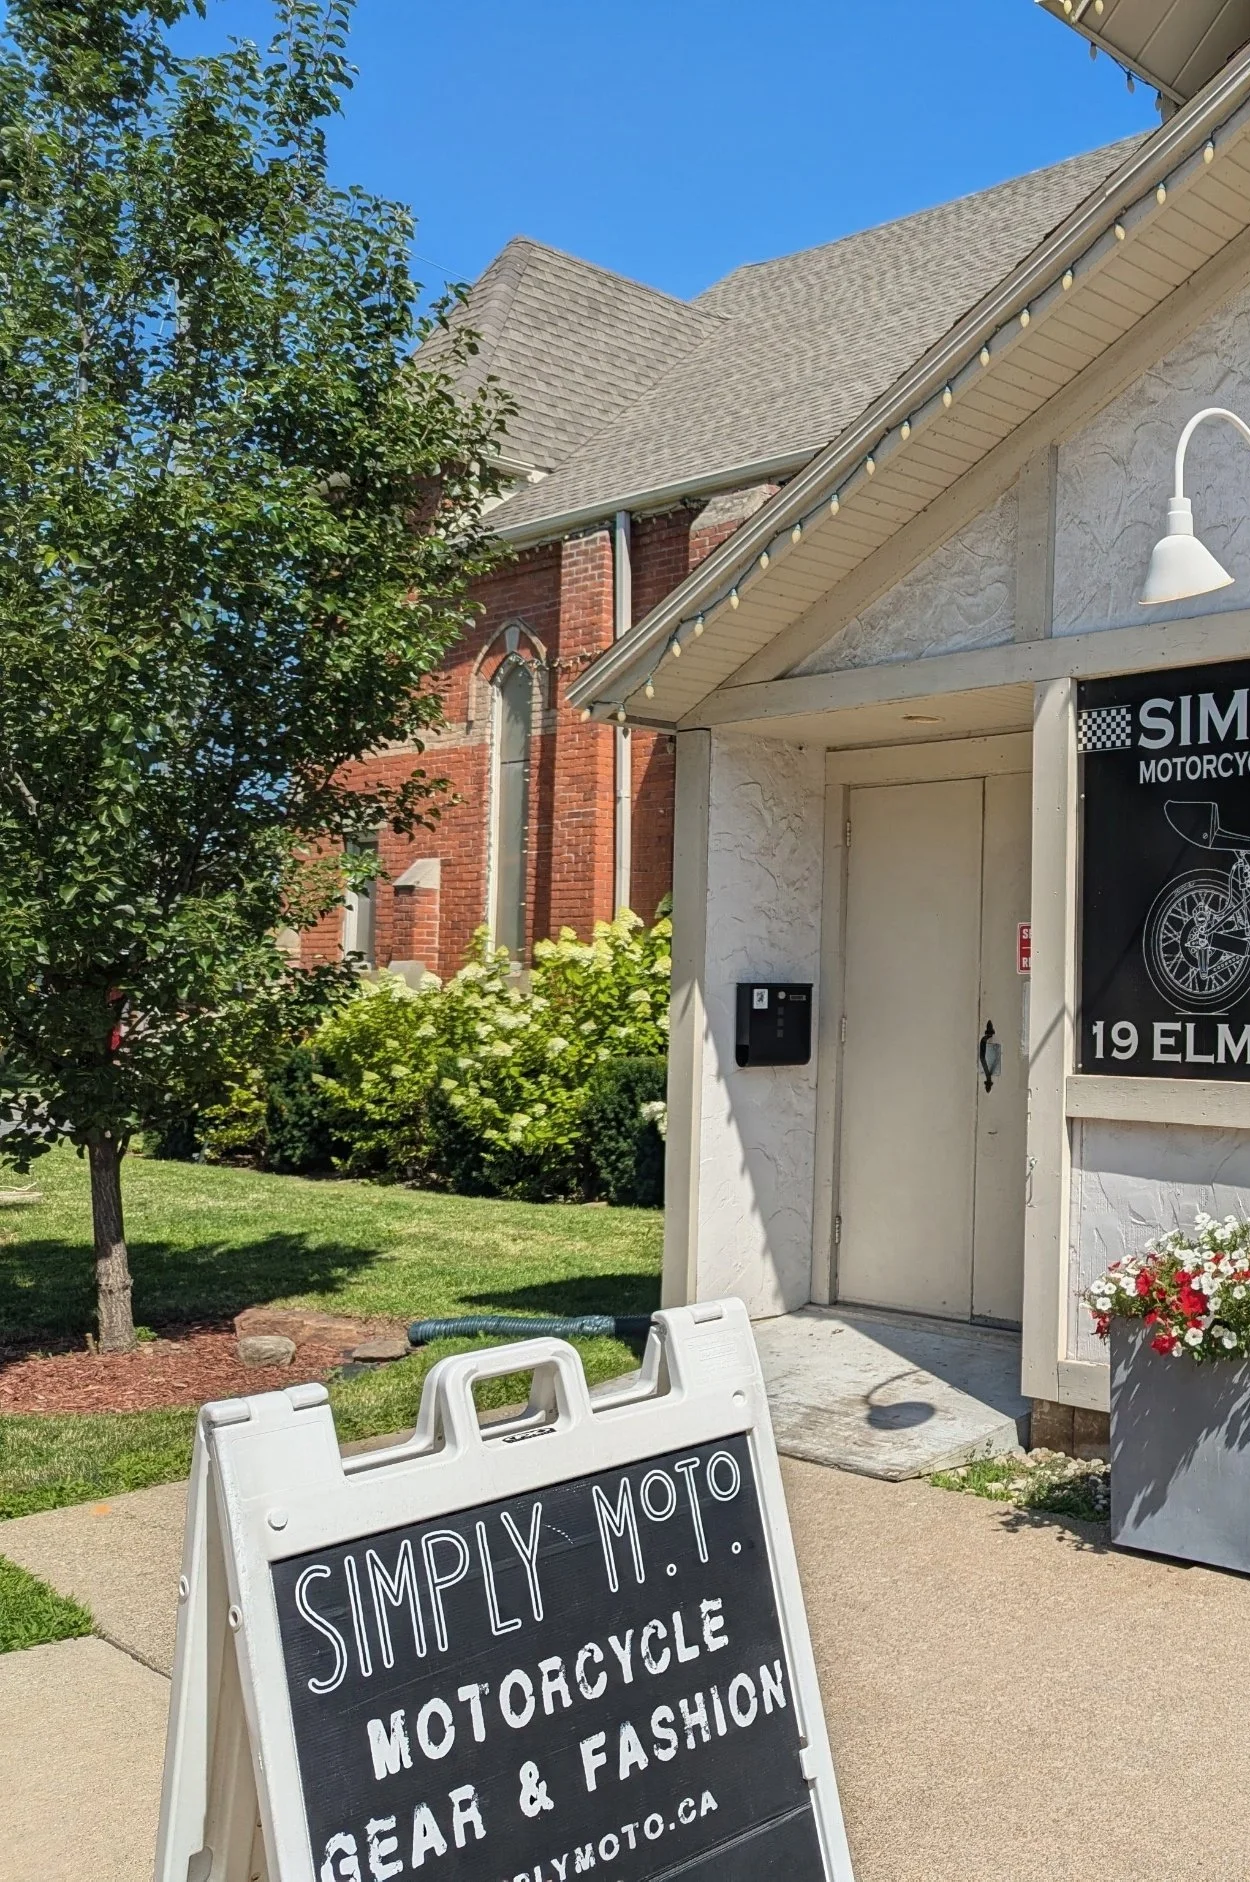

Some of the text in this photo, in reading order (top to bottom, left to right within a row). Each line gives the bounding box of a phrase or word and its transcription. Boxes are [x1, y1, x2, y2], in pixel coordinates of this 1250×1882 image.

[1022, 928, 1032, 939] S
[1022, 957, 1032, 968] R
[1092, 1020, 1138, 1059] 19
[295, 1502, 542, 1694] SIMPLY
[367, 1598, 730, 1780] MOTORCYCLE
[320, 1659, 787, 1882] GEAR & FASHION
